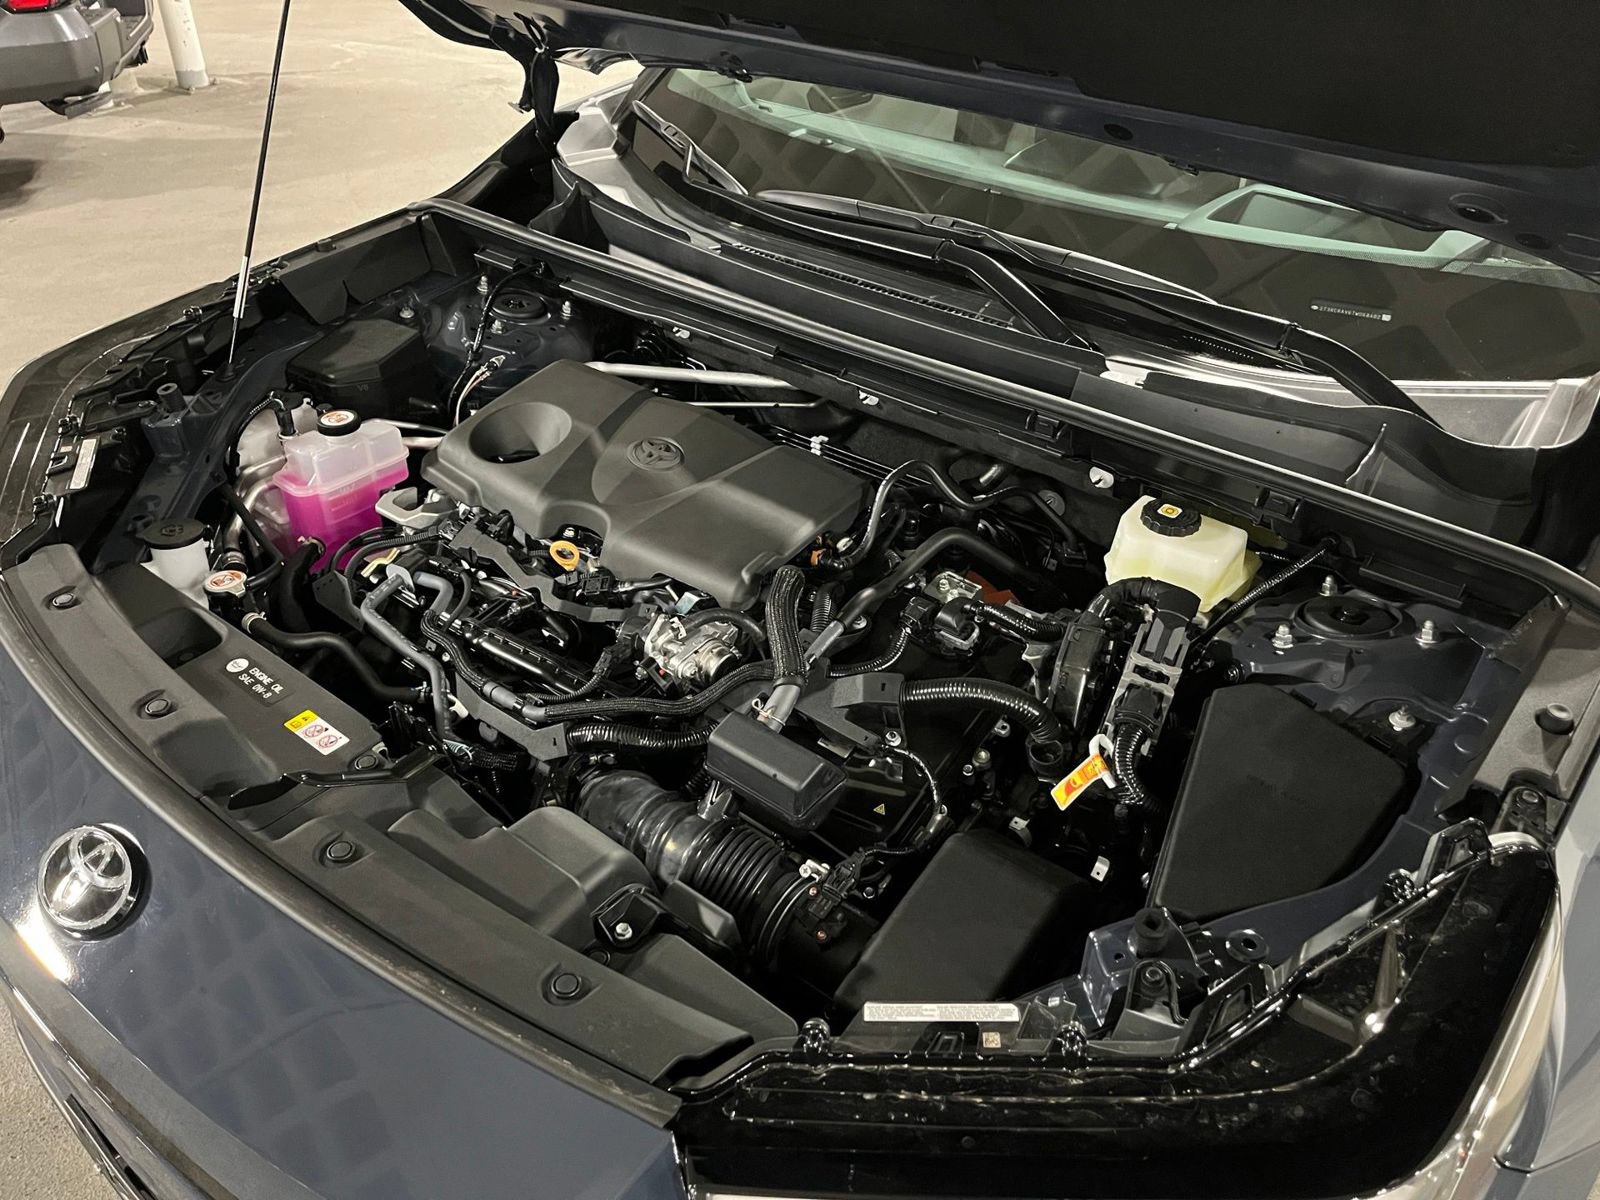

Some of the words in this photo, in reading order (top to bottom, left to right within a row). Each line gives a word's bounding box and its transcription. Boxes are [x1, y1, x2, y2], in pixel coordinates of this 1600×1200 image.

[238, 673, 255, 685] SAE
[251, 683, 273, 699] 0W-8
[248, 667, 274, 686] ENGINE
[270, 683, 284, 694] OIL
